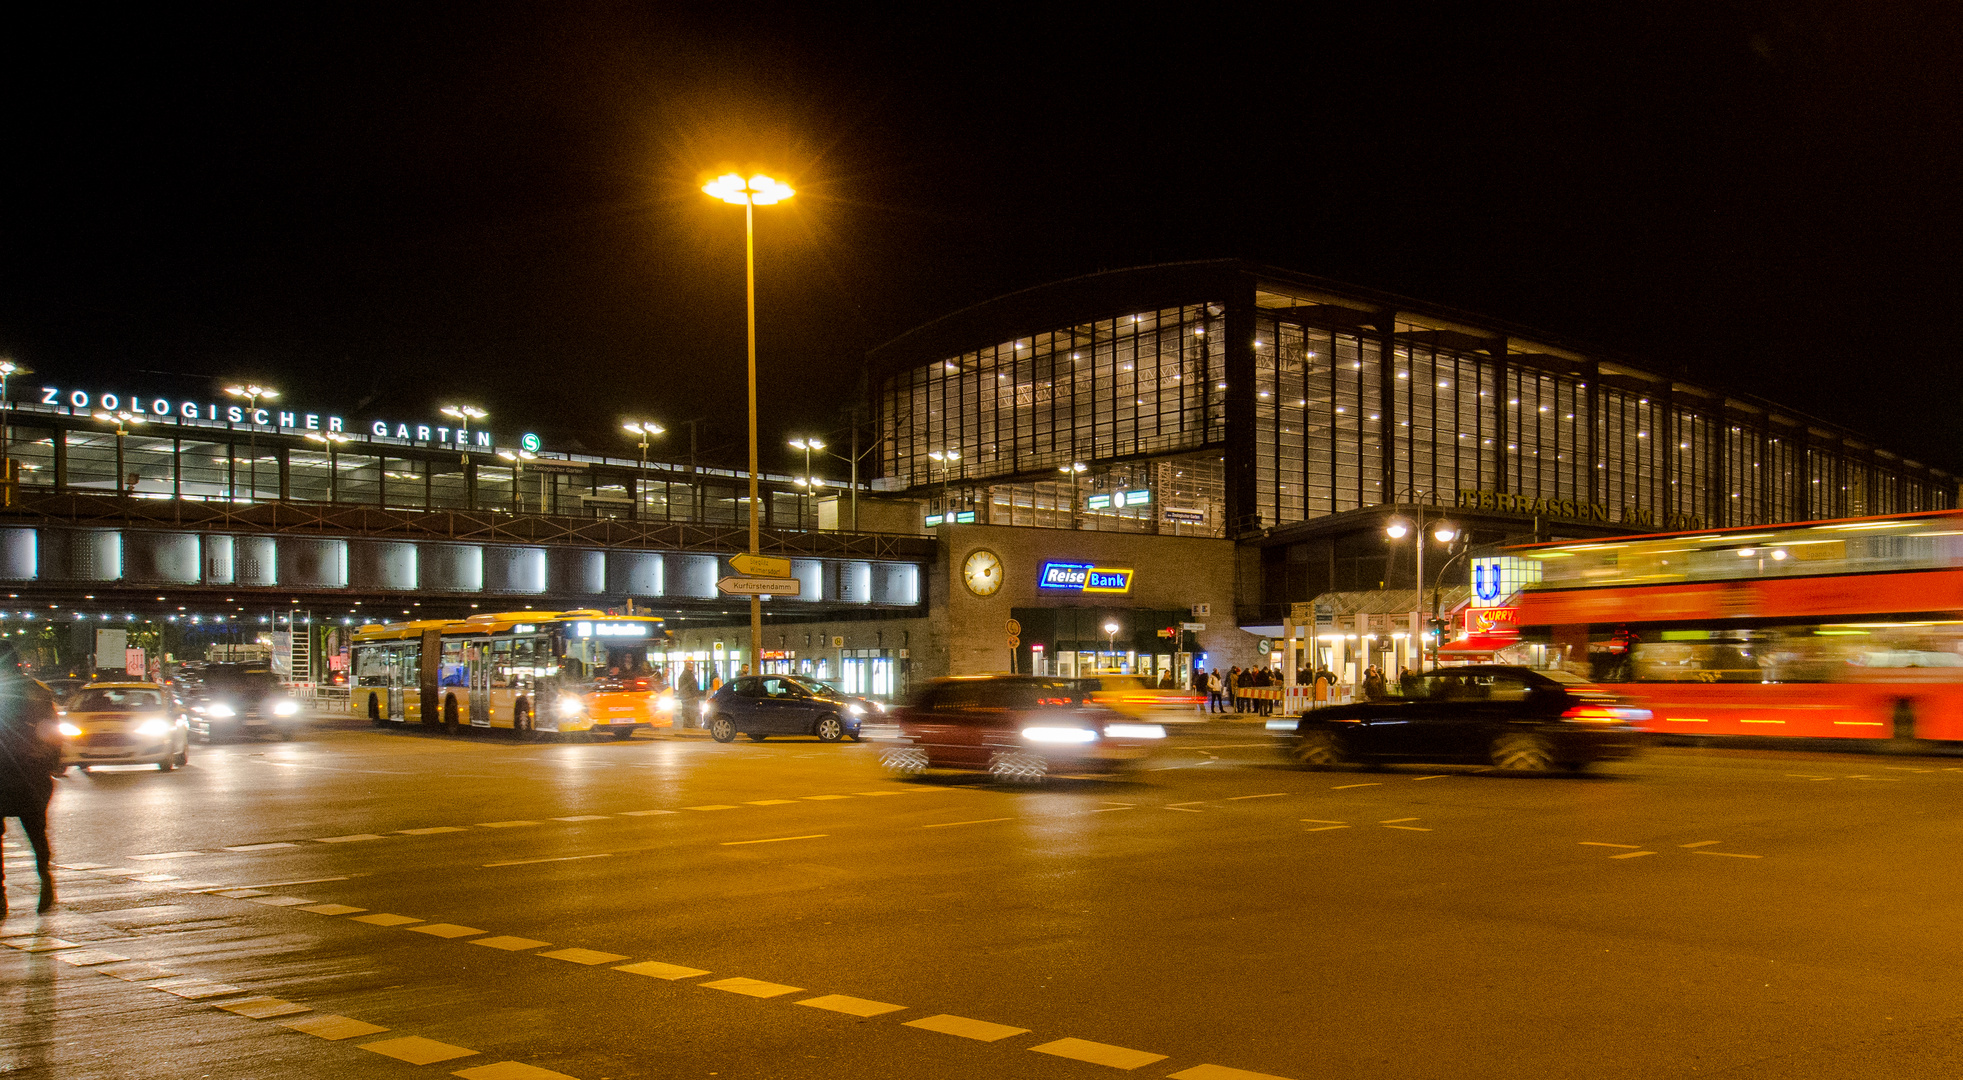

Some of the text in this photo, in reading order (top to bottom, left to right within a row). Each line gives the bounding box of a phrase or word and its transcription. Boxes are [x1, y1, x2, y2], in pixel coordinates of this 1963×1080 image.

[42, 387, 490, 446] ZOOLOGISCHER GARTEN
[1459, 488, 1701, 531] TERRASSEN AM ZOO
[733, 582, 792, 591] Kurfürstendamm
[1047, 568, 1125, 588] Reise Bank
[1475, 564, 1501, 601] U
[1482, 610, 1514, 621] CURRY
